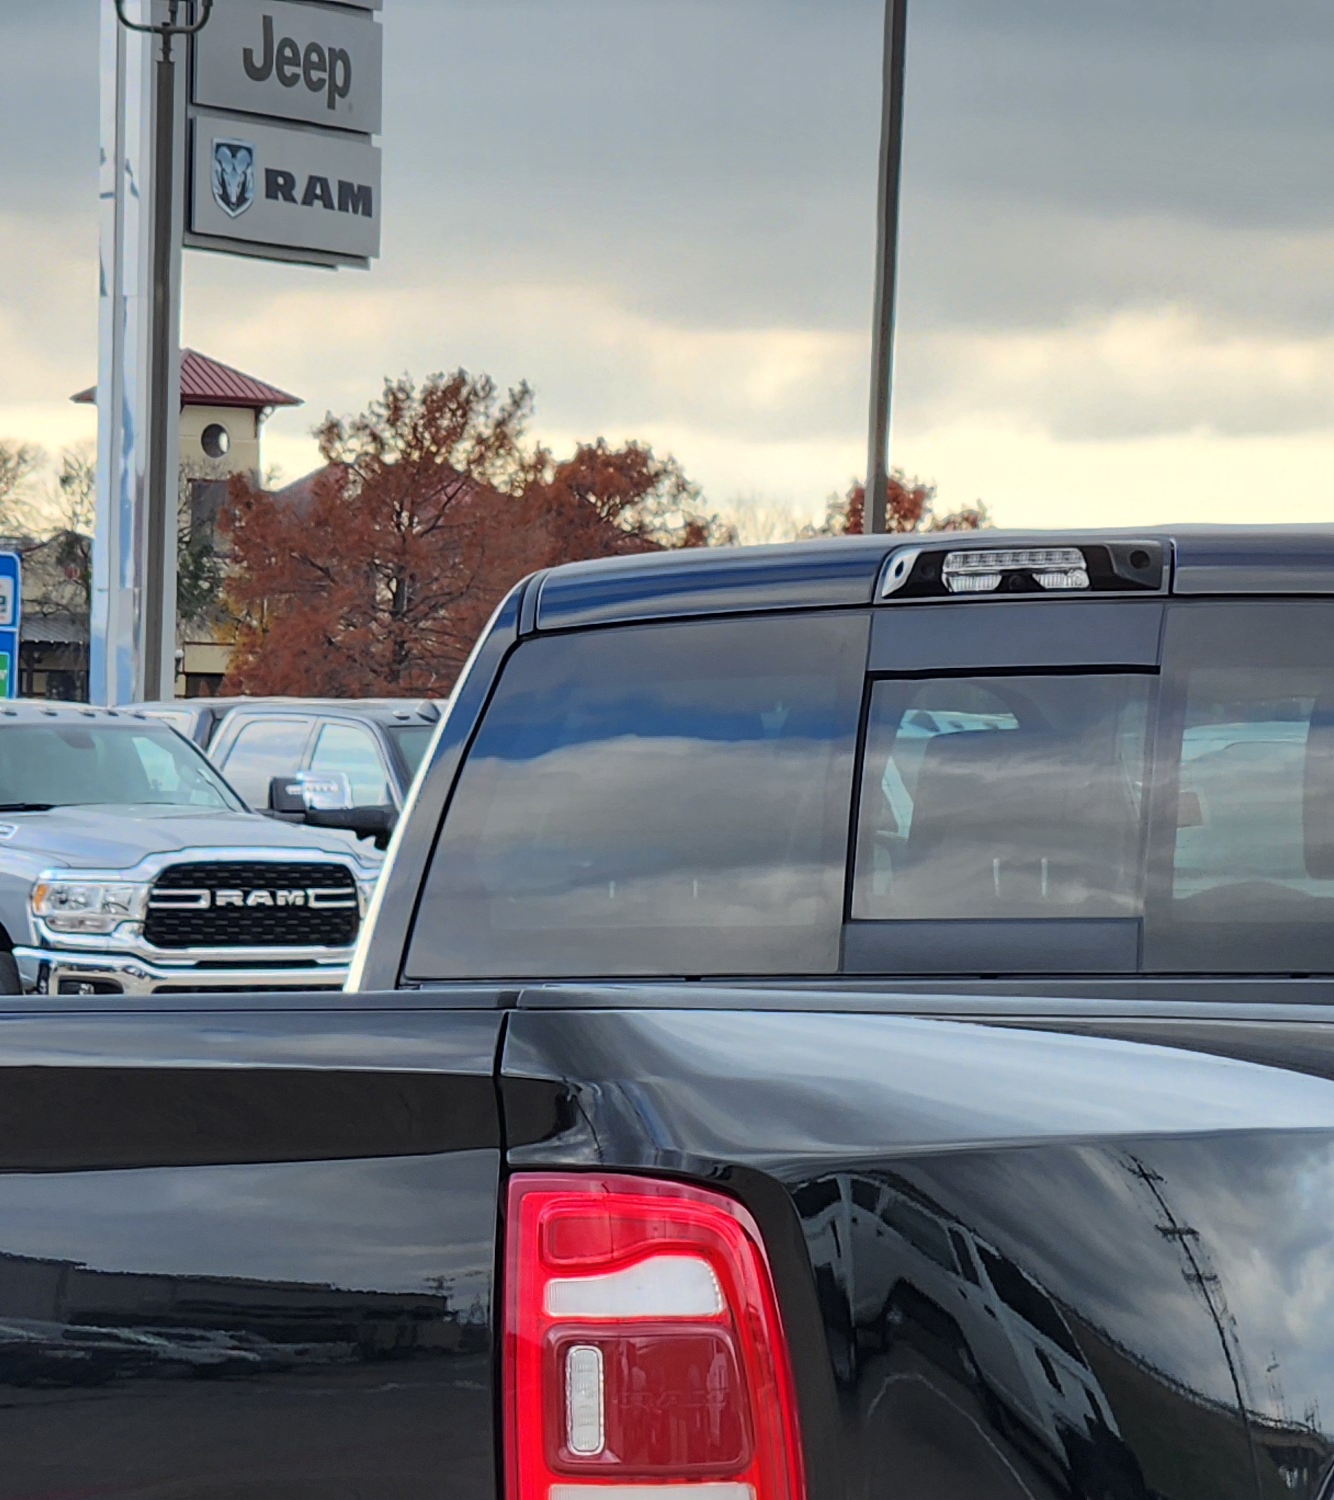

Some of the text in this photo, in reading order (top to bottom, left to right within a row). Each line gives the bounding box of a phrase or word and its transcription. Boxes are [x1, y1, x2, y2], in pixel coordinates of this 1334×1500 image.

[243, 14, 352, 110] Jeep
[264, 168, 373, 218] RAM
[215, 889, 305, 906] RAM
